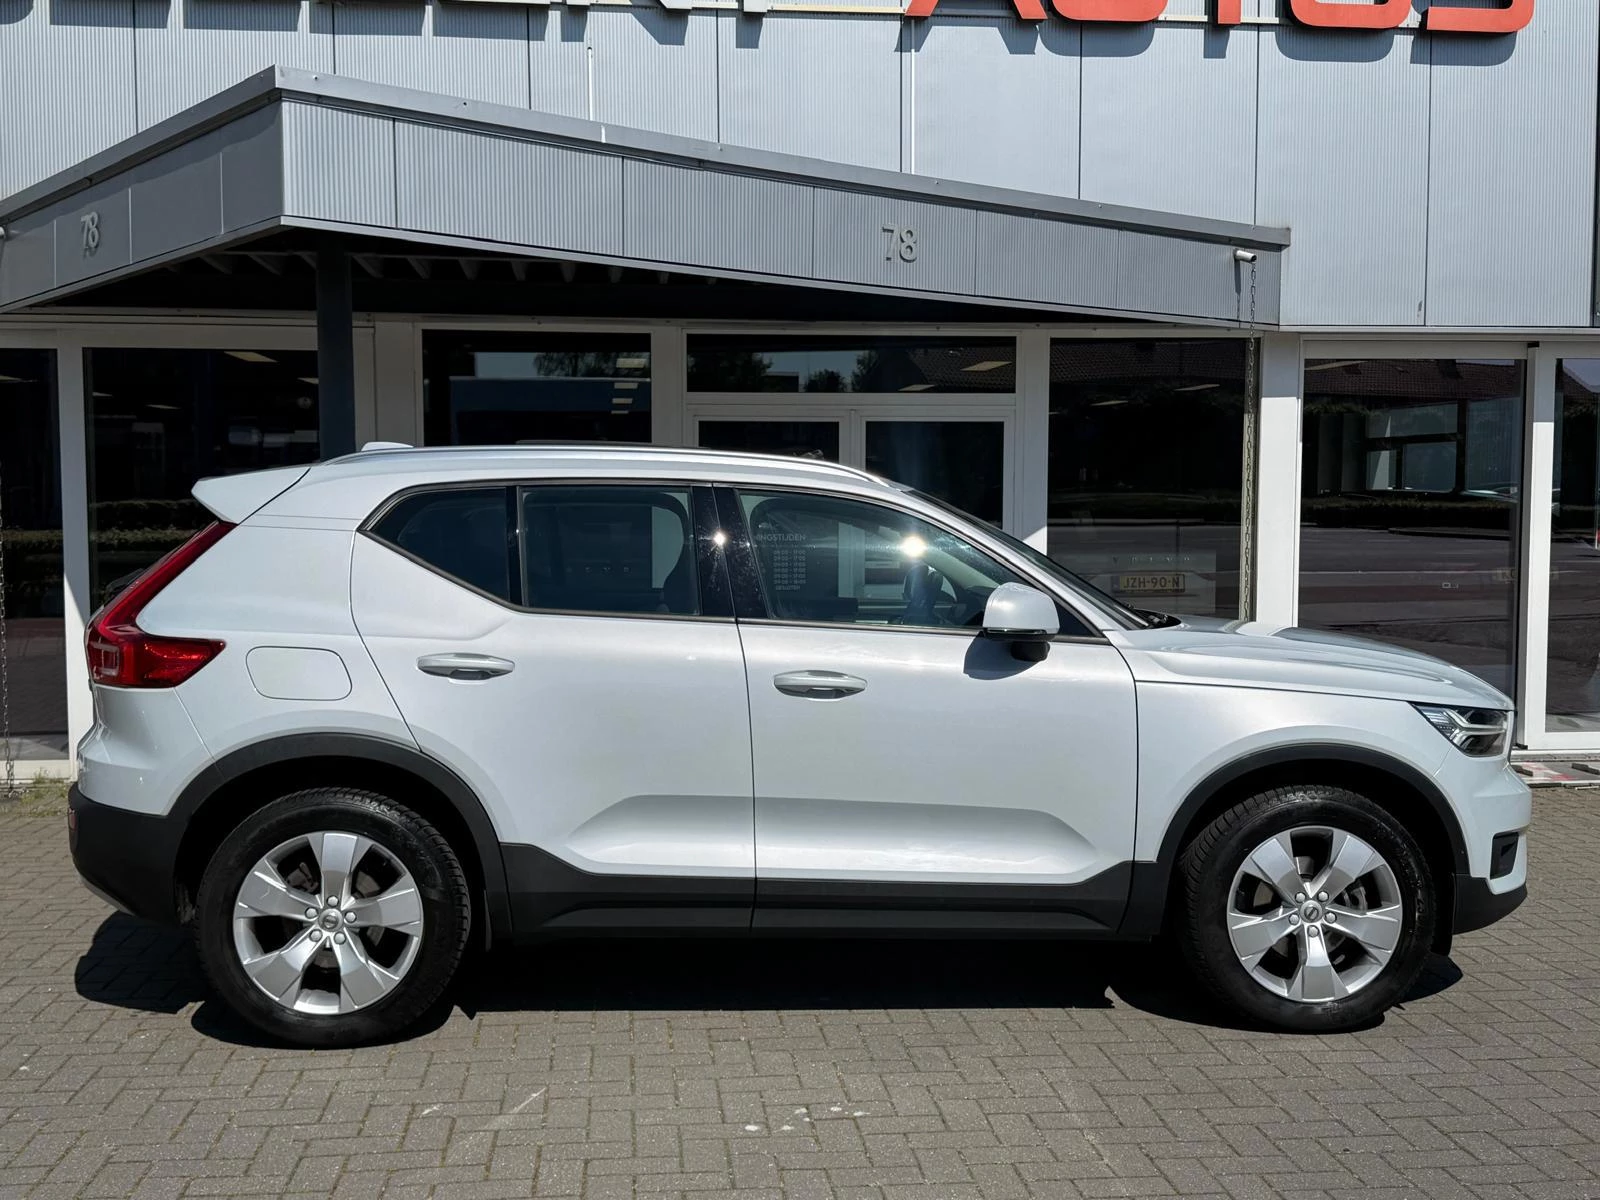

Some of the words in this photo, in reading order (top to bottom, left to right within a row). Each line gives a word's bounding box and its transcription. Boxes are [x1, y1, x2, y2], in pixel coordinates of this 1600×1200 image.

[80, 211, 99, 248] 78
[881, 223, 918, 262] 78
[1123, 576, 1180, 589] JZH-90-N
